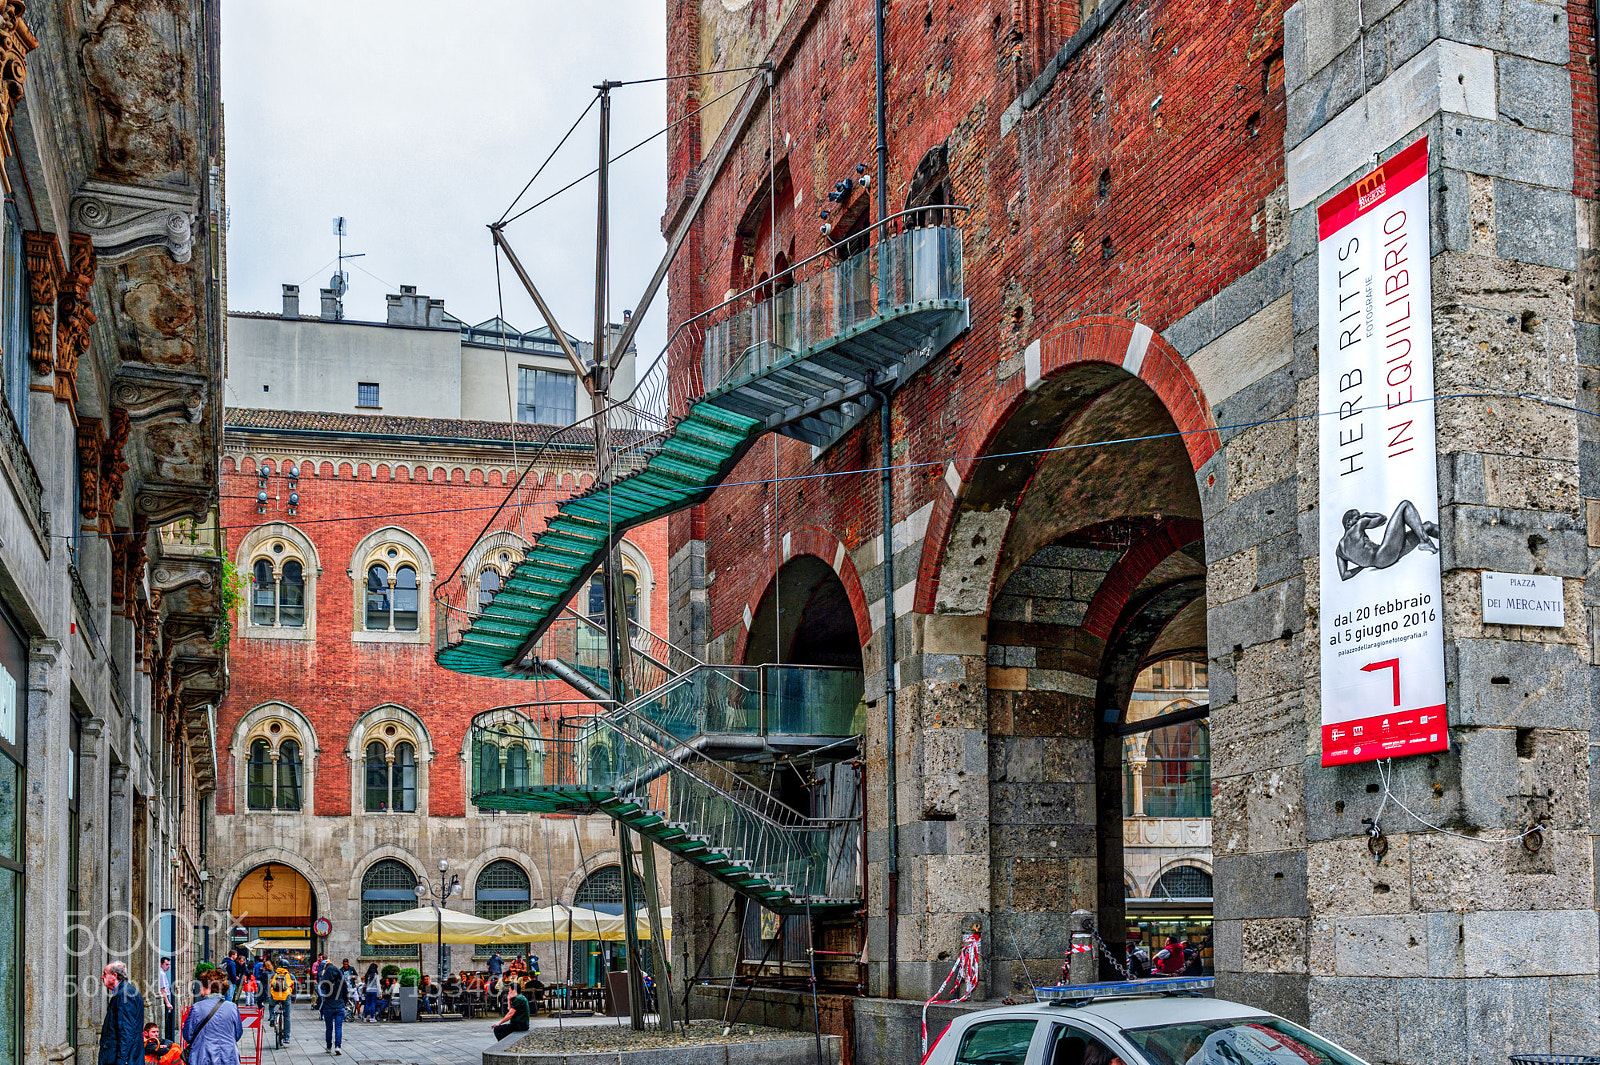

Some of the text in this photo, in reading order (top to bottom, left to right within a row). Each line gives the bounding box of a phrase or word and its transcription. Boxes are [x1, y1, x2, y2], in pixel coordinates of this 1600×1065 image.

[1365, 274, 1374, 338] FOTOGRAFIE
[1383, 210, 1414, 458] IN EQUILIBRIO
[1338, 237, 1364, 477] HERB RITTS
[1510, 578, 1536, 588] PIAZZA
[1334, 593, 1431, 627] dal 20 febbraio
[1487, 598, 1561, 612] DEI MERCANTI
[1329, 608, 1436, 646] al 5 giugno 2016
